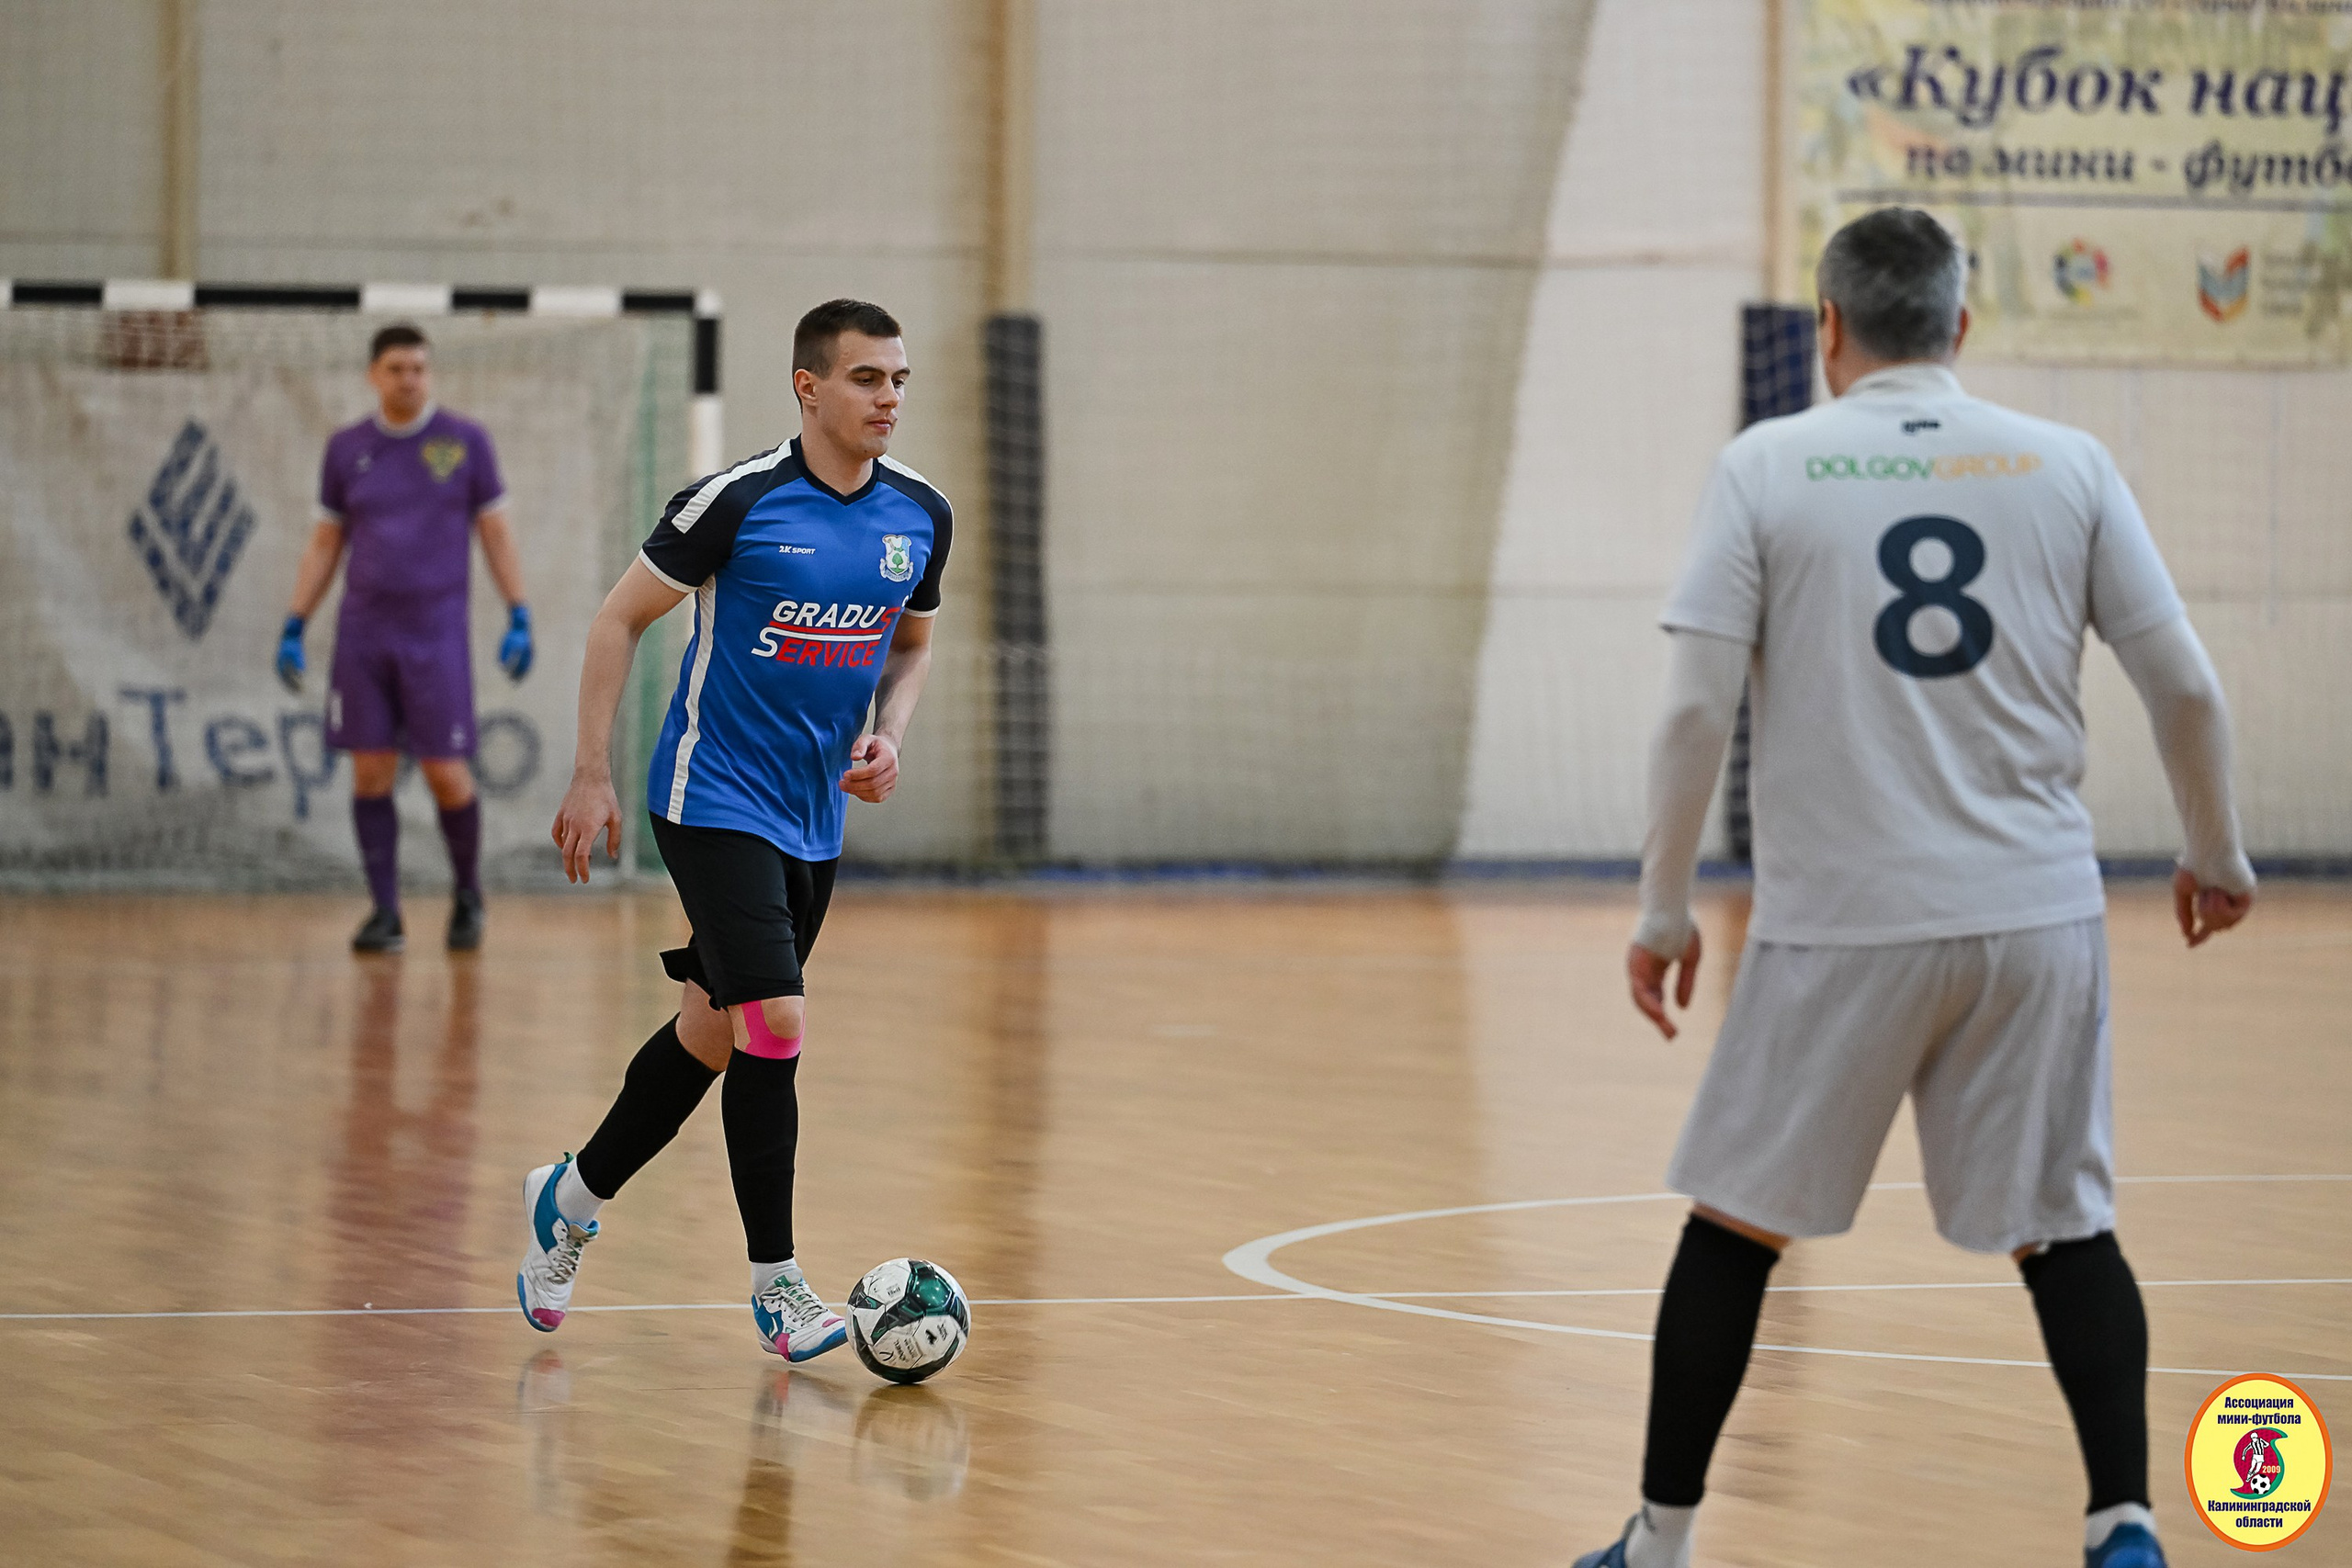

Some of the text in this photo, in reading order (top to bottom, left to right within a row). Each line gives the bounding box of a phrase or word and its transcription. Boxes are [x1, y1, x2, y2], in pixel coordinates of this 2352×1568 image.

[1847, 43, 2163, 128] «Кубок
[1905, 144, 1973, 181] по
[1983, 145, 2134, 183] мини
[2182, 138, 2352, 195] футб
[1804, 453, 2042, 481] DOLGOVGROUP
[770, 600, 900, 634] GRADUS
[1873, 513, 1994, 680] 8
[751, 626, 883, 668] SERVICE
[0, 682, 542, 819] нТеро
